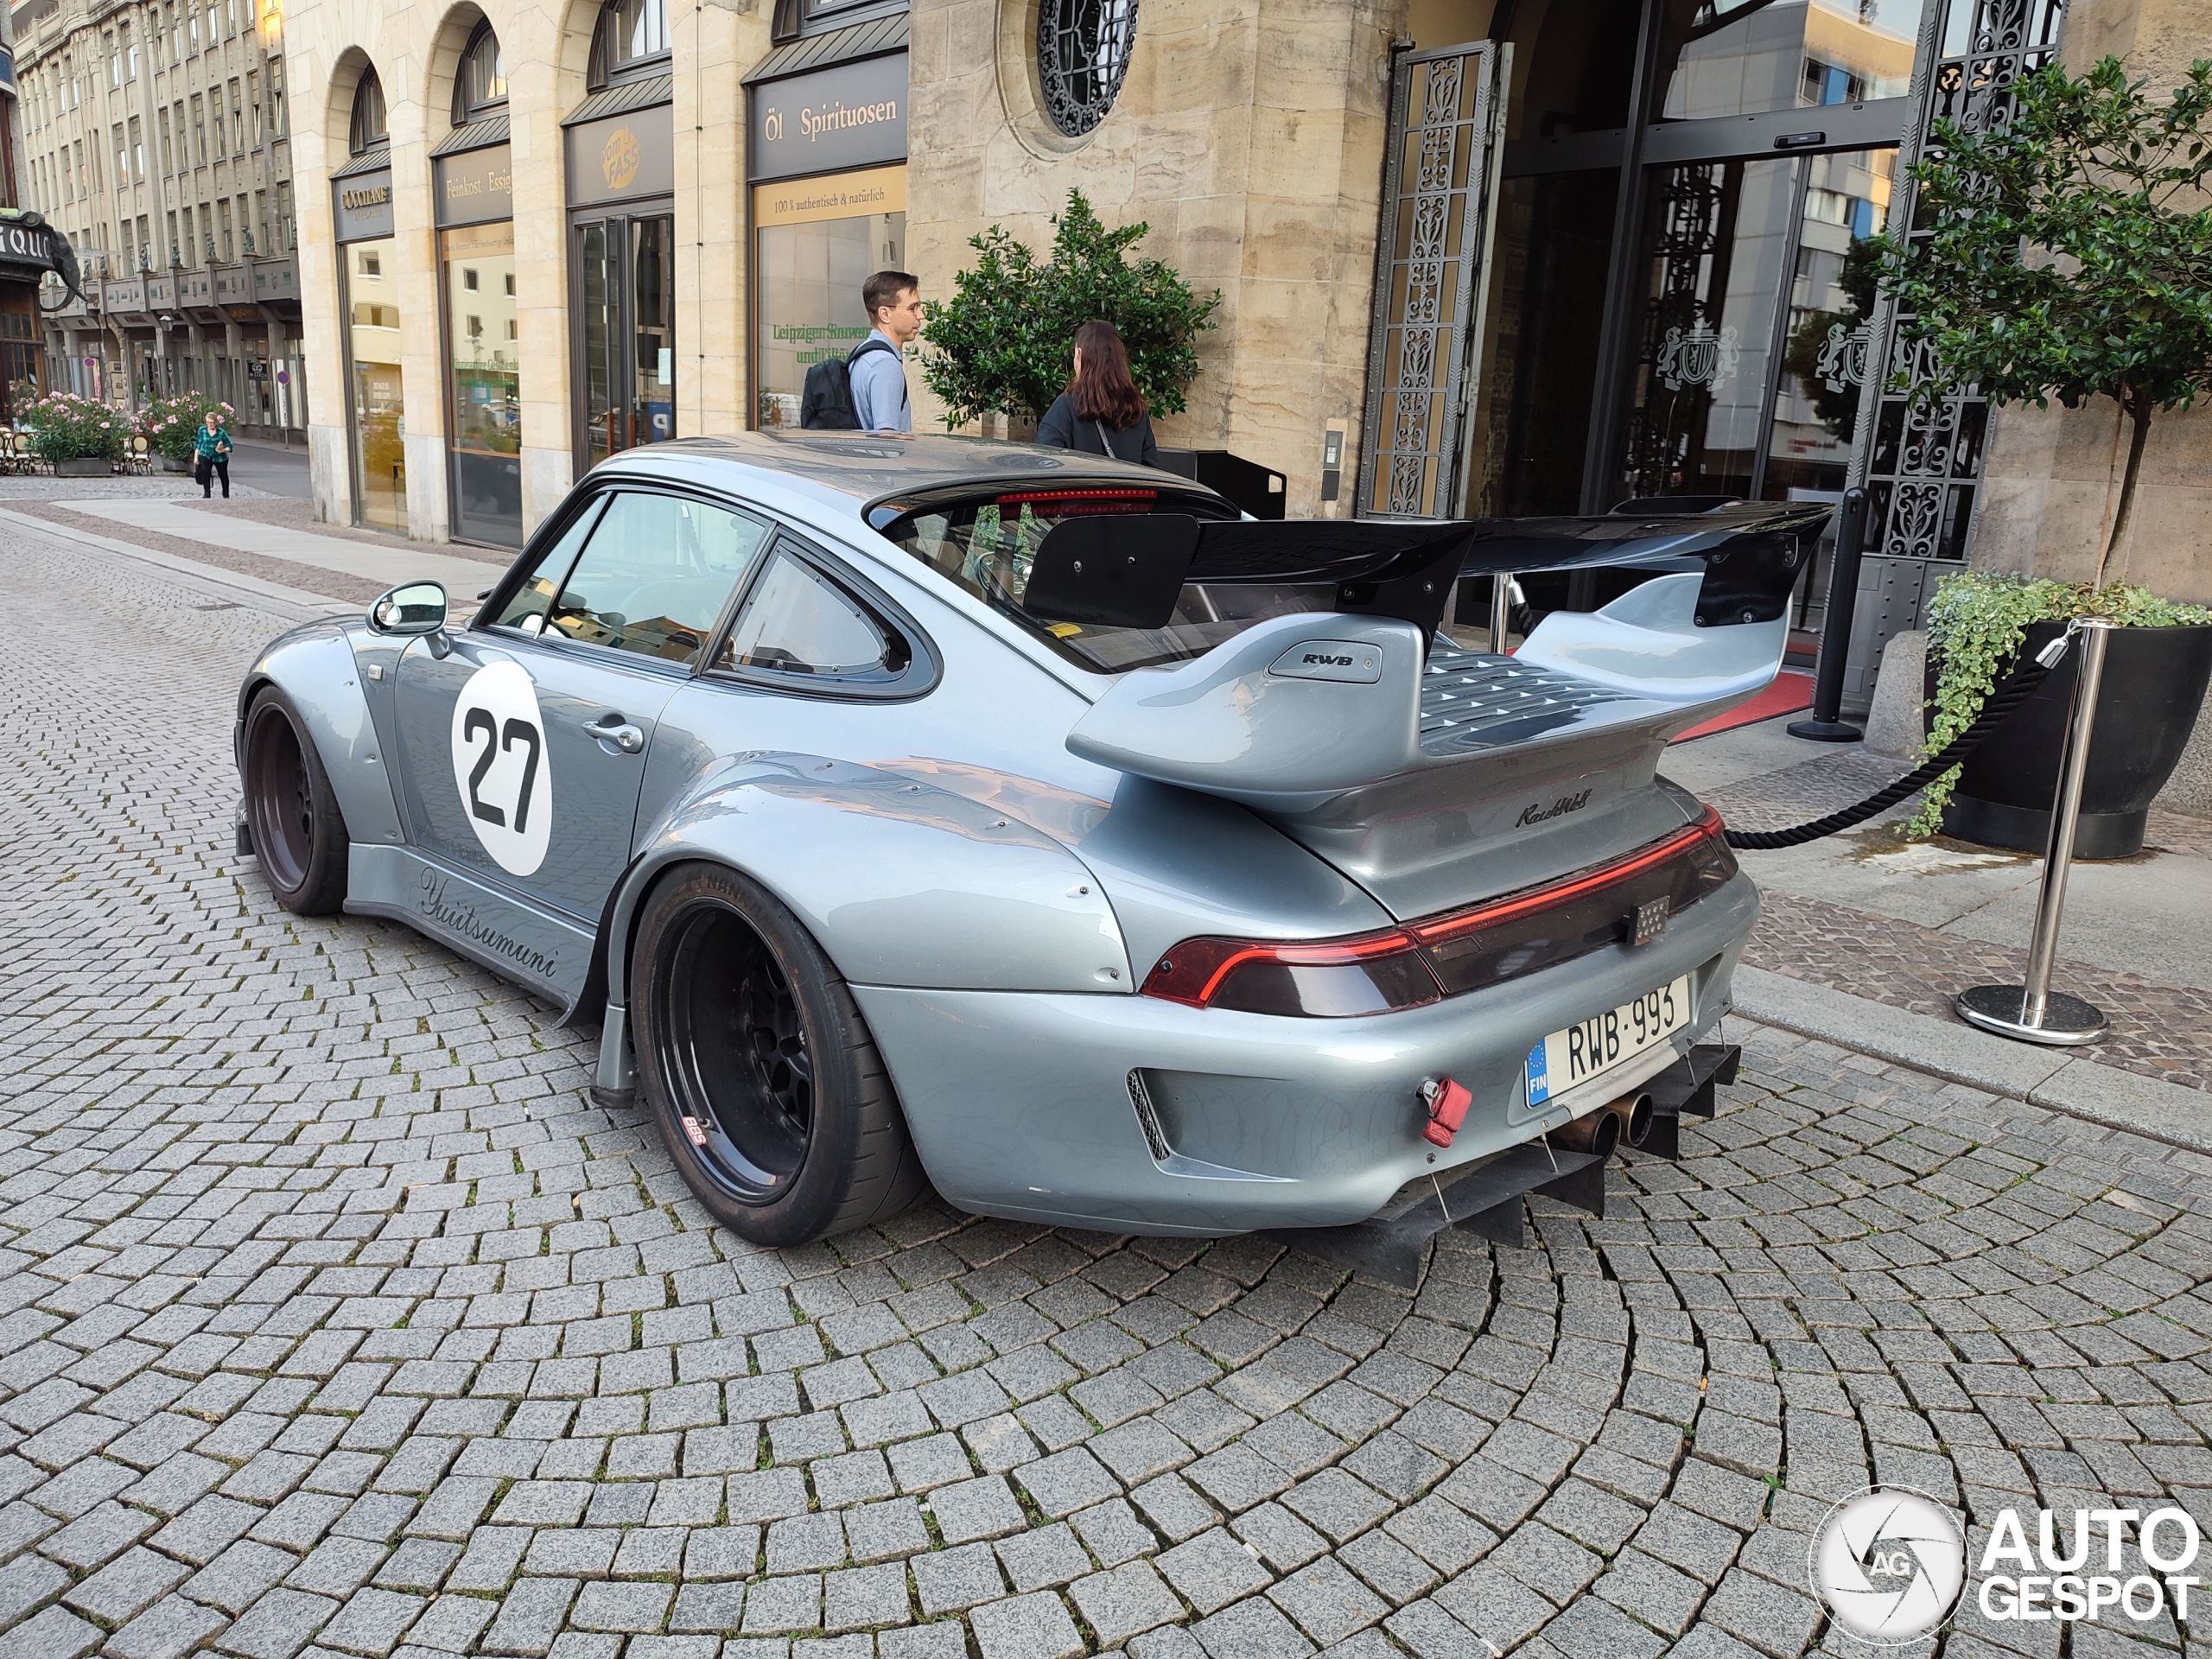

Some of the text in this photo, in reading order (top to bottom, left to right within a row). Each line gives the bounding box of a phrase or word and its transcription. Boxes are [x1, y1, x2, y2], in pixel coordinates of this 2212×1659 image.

[765, 100, 897, 143] Öl Spirituosen
[608, 143, 639, 187] FASS
[446, 168, 512, 199] Feinkost Essig
[774, 200, 788, 213] 100
[796, 194, 838, 211] authentisch
[841, 193, 847, 207] &
[849, 187, 885, 205] natürlich
[773, 323, 824, 344] Leipziger
[1302, 653, 1353, 666] RWB
[464, 707, 541, 835] 27
[1568, 982, 1675, 1081] RWB-993
[1529, 1073, 1548, 1094] FIN
[683, 1116, 707, 1146] BBS
